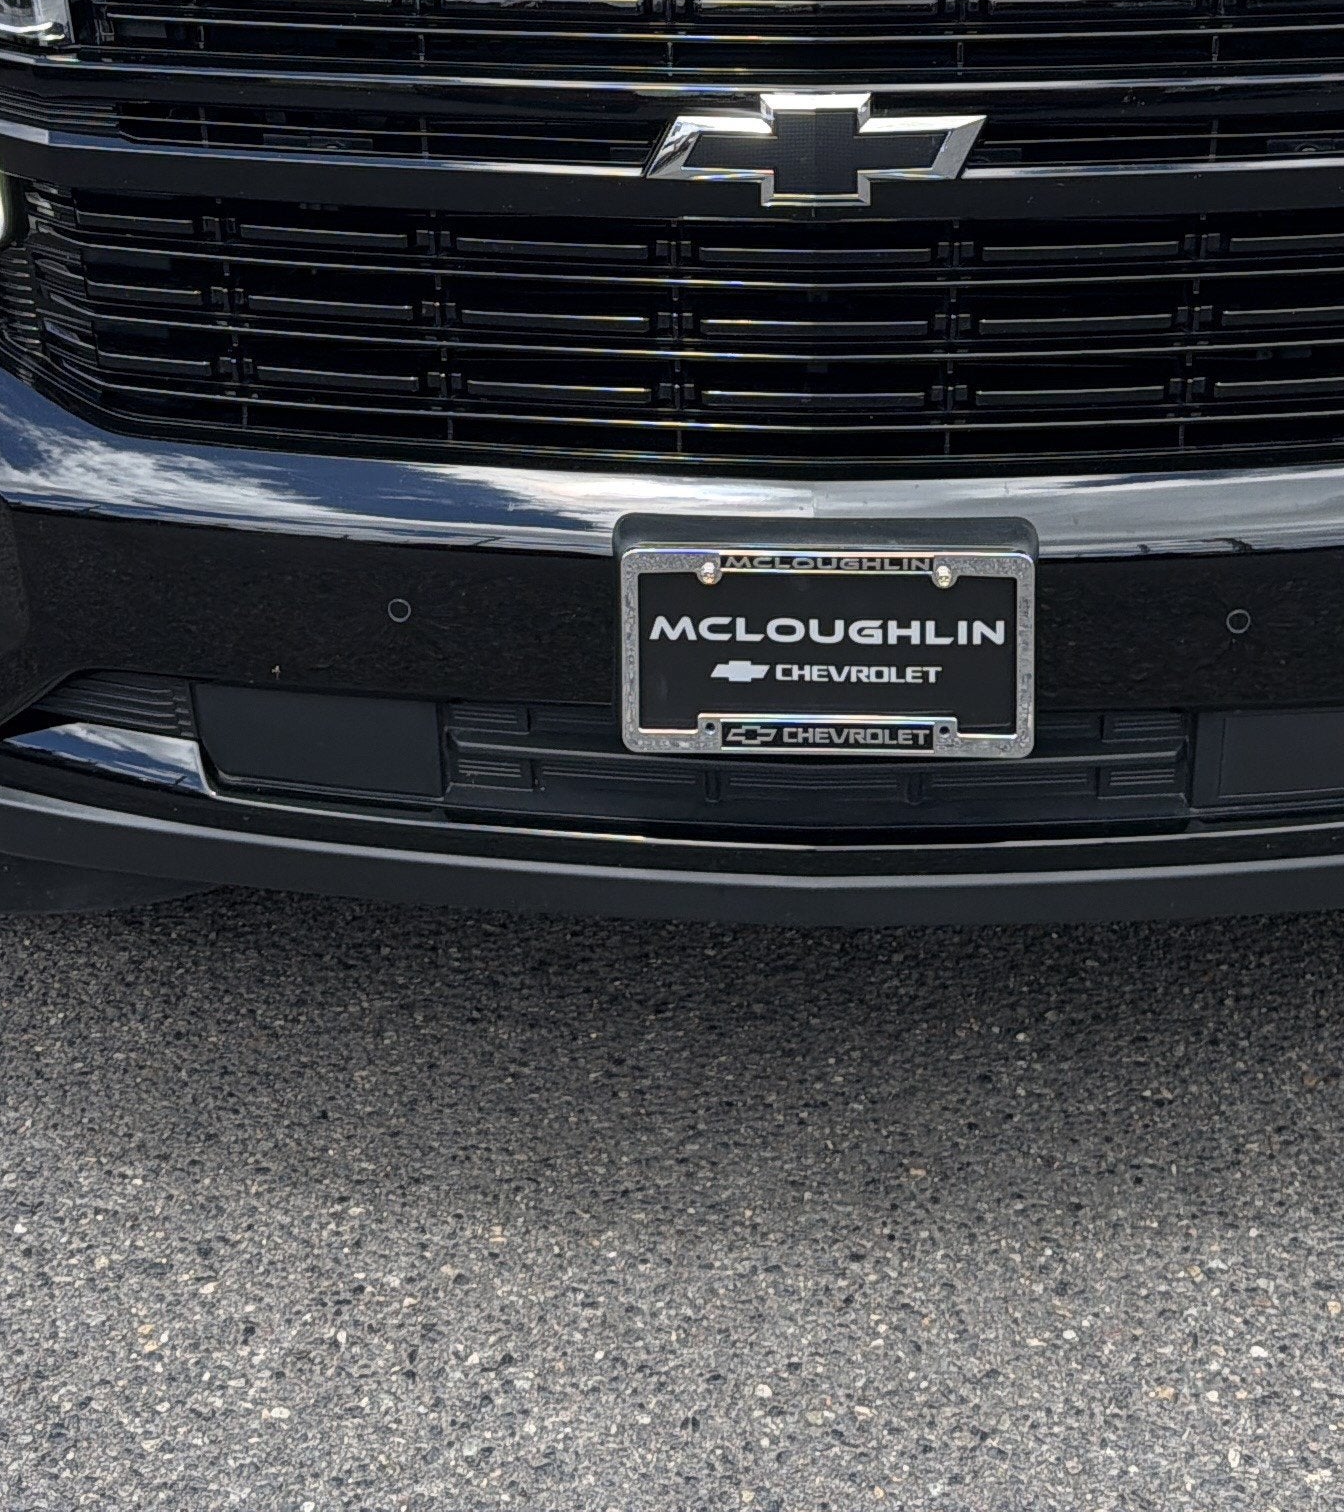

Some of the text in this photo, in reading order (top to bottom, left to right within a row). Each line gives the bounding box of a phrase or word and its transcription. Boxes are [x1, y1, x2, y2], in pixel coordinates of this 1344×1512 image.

[725, 555, 931, 572] MCLOUGHLIN
[649, 615, 1006, 646] MCLOUGHLIN
[775, 664, 943, 684] CHEVROLET
[782, 727, 930, 746] CHEVROLET
